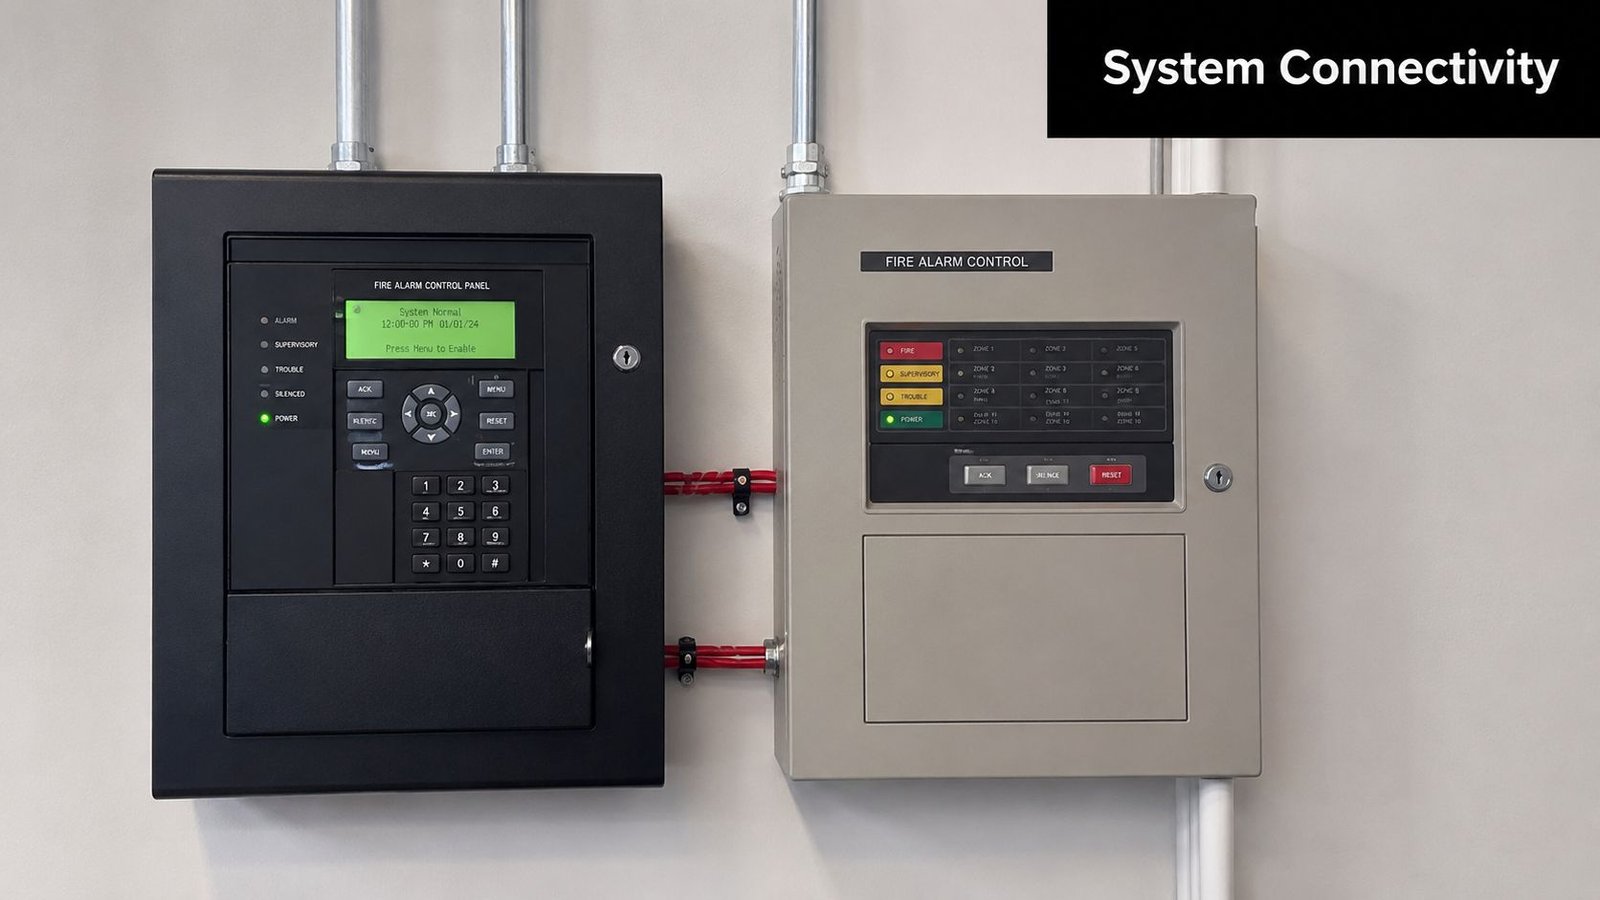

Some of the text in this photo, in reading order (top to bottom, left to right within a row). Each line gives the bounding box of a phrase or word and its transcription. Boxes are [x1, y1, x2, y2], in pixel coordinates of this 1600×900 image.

[885, 256, 1029, 268] FIRE ALARM CONTROL
[374, 281, 490, 290] FIRE ALARM CONTROL PANEL
[432, 307, 462, 316] Normal
[274, 316, 297, 325] ALARM
[274, 341, 319, 349] SUPERVISORY
[385, 344, 410, 353] Press
[436, 344, 446, 353] to
[449, 344, 476, 353] Enable
[275, 365, 304, 374] TROUBLE
[900, 370, 940, 378] SUPERVISORY
[274, 389, 305, 398] SILENCED
[357, 385, 373, 393] ACK
[901, 393, 928, 401] TROUBLE
[274, 414, 298, 422] POWER
[486, 417, 507, 425] RESET
[482, 447, 504, 456] ENTER
[1101, 471, 1122, 479] RESET
[423, 480, 429, 491] 1
[457, 480, 464, 491] 2
[492, 480, 499, 490] 3
[422, 506, 430, 517] 4
[457, 506, 464, 516] 5
[492, 505, 499, 516] 6
[422, 532, 430, 542] 7
[457, 532, 464, 542] 8
[492, 532, 499, 542] 9
[457, 559, 464, 568] 0
[491, 558, 499, 568] #
